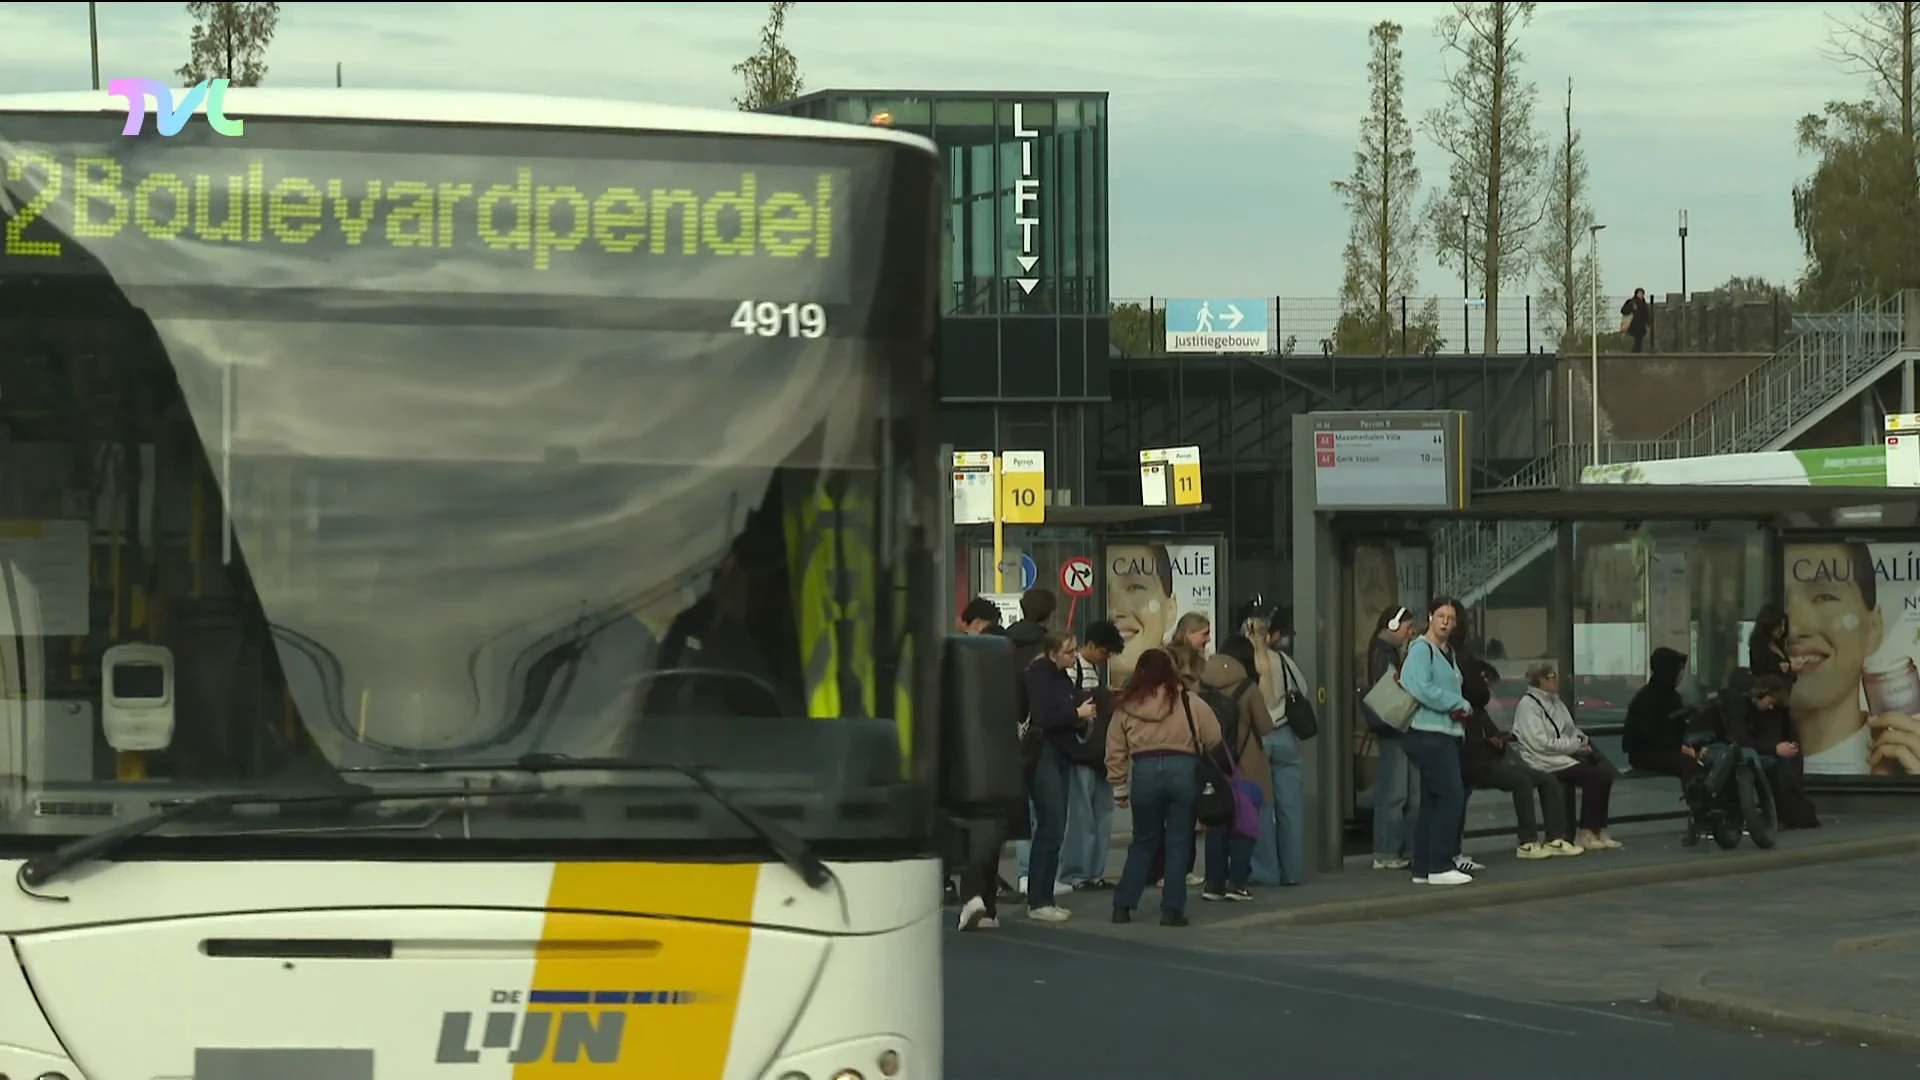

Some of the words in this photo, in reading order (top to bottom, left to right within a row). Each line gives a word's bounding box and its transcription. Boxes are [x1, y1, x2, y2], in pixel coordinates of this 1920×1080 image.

[1013, 102, 1040, 253] LIFT
[73, 155, 832, 270] Boulevardpendel
[730, 300, 827, 339] 4919
[1174, 334, 1261, 350] Justitiegebouw
[1013, 457, 1034, 467] Perron
[1420, 453, 1431, 463] 10
[1178, 476, 1193, 492] 11
[1011, 488, 1036, 507] 10
[1112, 551, 1211, 577] CAUALÍE
[490, 989, 522, 1004] DE
[434, 1011, 628, 1064] LIJN
